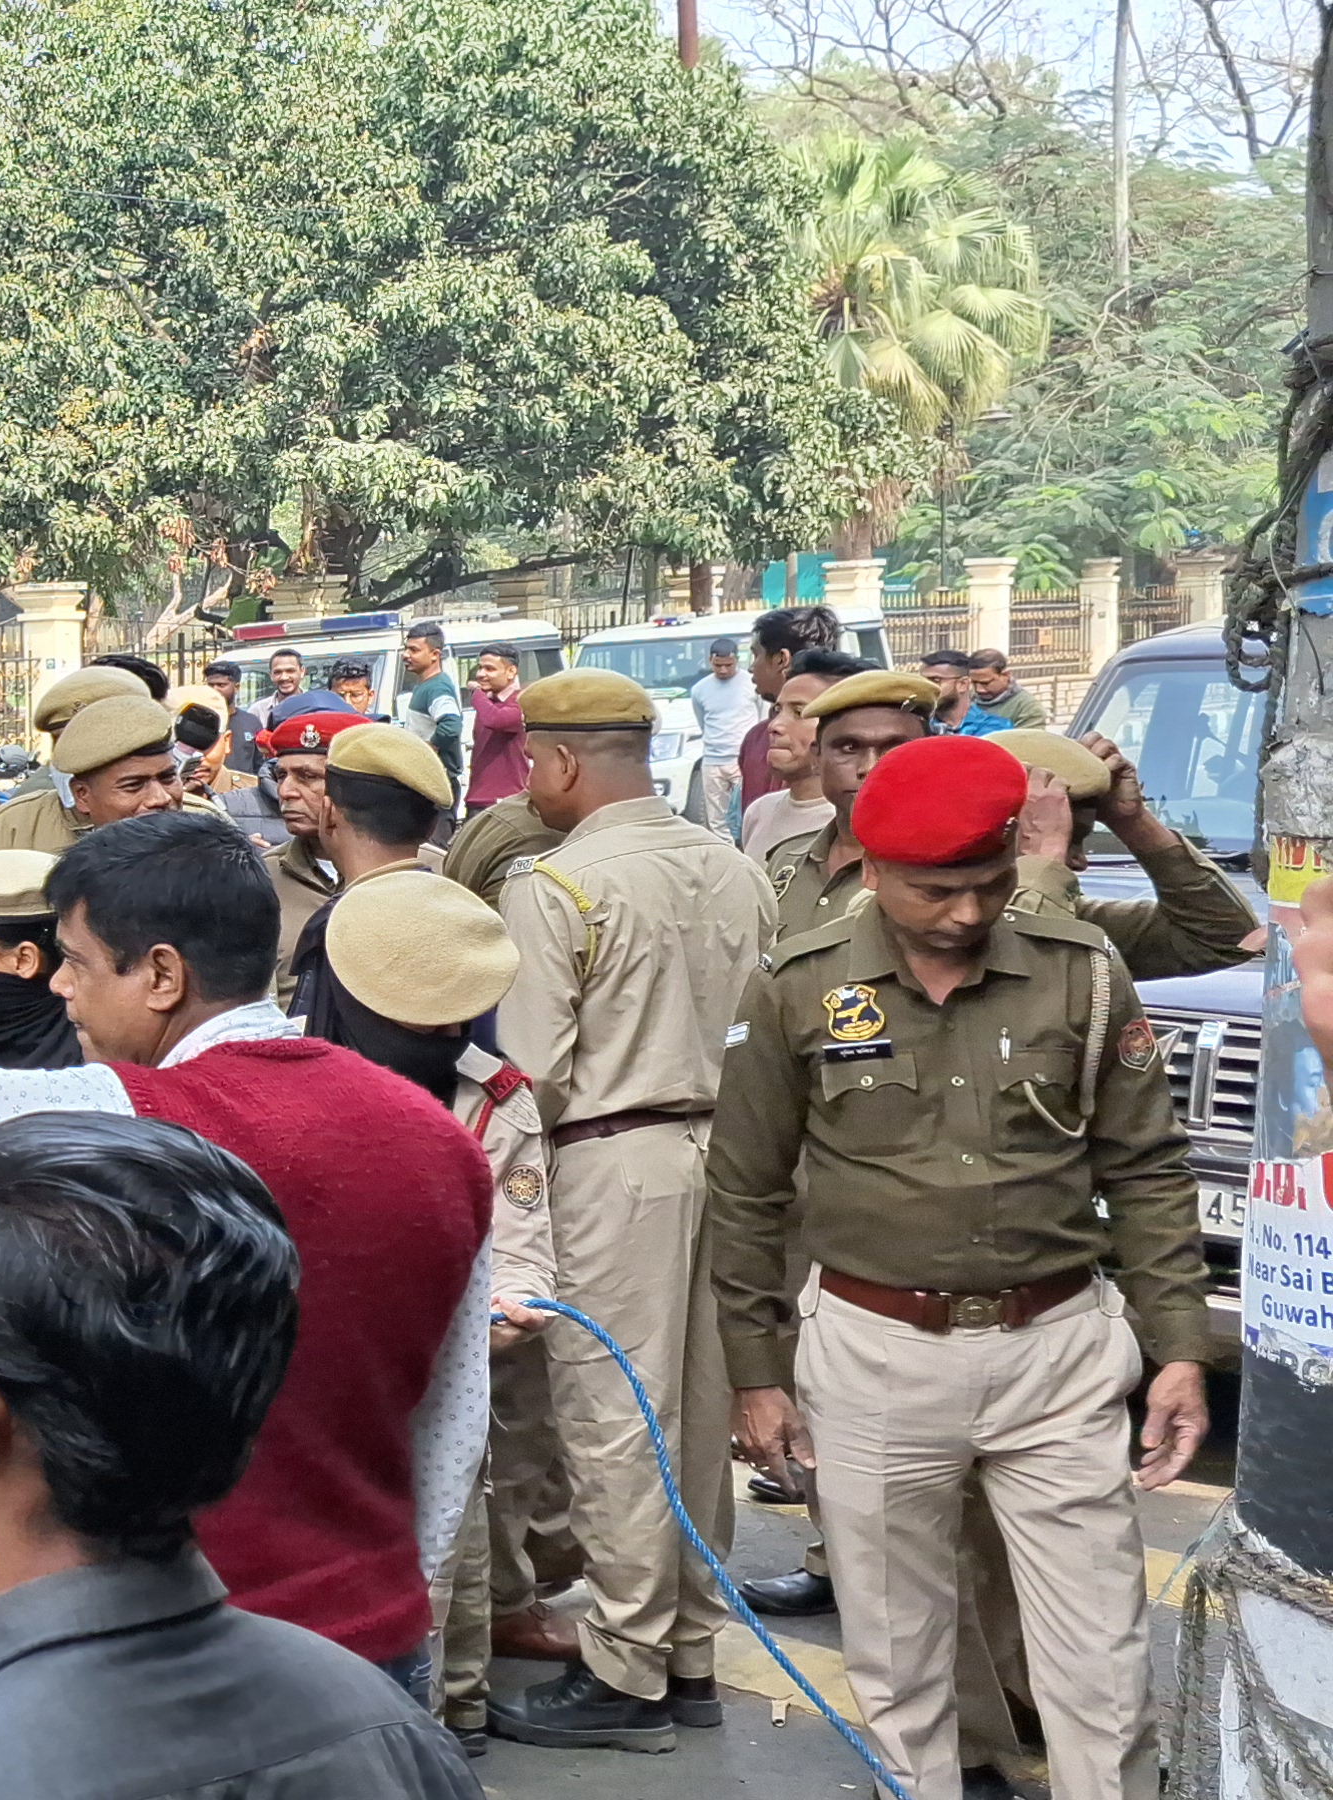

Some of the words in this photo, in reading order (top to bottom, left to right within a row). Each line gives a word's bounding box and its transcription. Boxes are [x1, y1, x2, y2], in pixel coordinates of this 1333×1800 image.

[1263, 1223, 1287, 1253] No.
[1294, 1232, 1332, 1260] 114
[1247, 1252, 1277, 1284] Near
[1280, 1264, 1313, 1293] Sai
